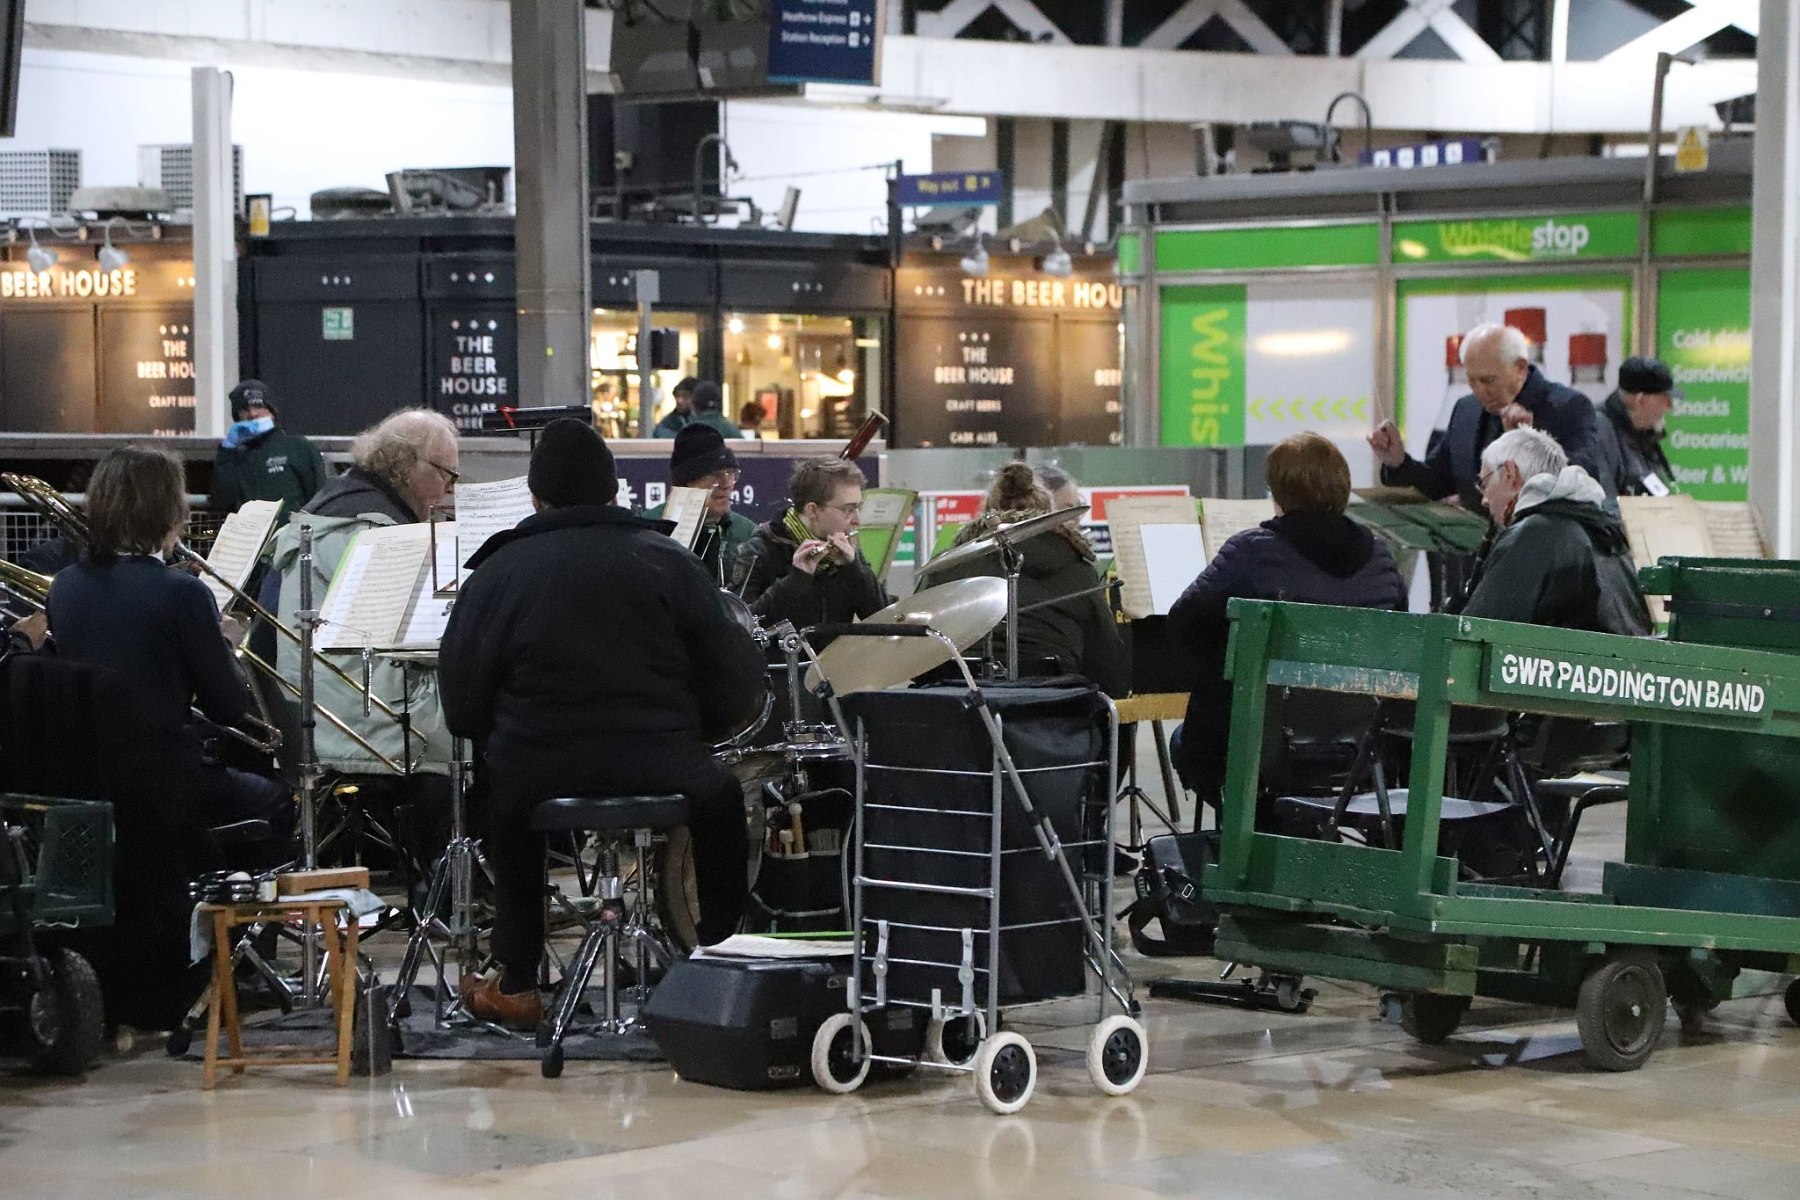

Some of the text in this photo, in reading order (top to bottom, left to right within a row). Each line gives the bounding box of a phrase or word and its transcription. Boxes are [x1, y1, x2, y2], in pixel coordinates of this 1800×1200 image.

[917, 179, 959, 195] Way out
[1, 270, 136, 297] BEER HOUSE
[962, 279, 1004, 305] THE
[1012, 280, 1065, 307] BEER
[162, 340, 187, 357] THE
[456, 336, 493, 354] THE
[962, 346, 988, 363] THE
[137, 361, 167, 379] BEER
[451, 356, 497, 374] BEER
[441, 376, 507, 394] HOUSE
[934, 367, 1014, 385] BEER HOUSE
[1671, 398, 1730, 417] Snacks
[1712, 465, 1726, 484] &
[743, 484, 754, 504] 9
[1502, 654, 1765, 713] GWR PADDINGTON BAND
